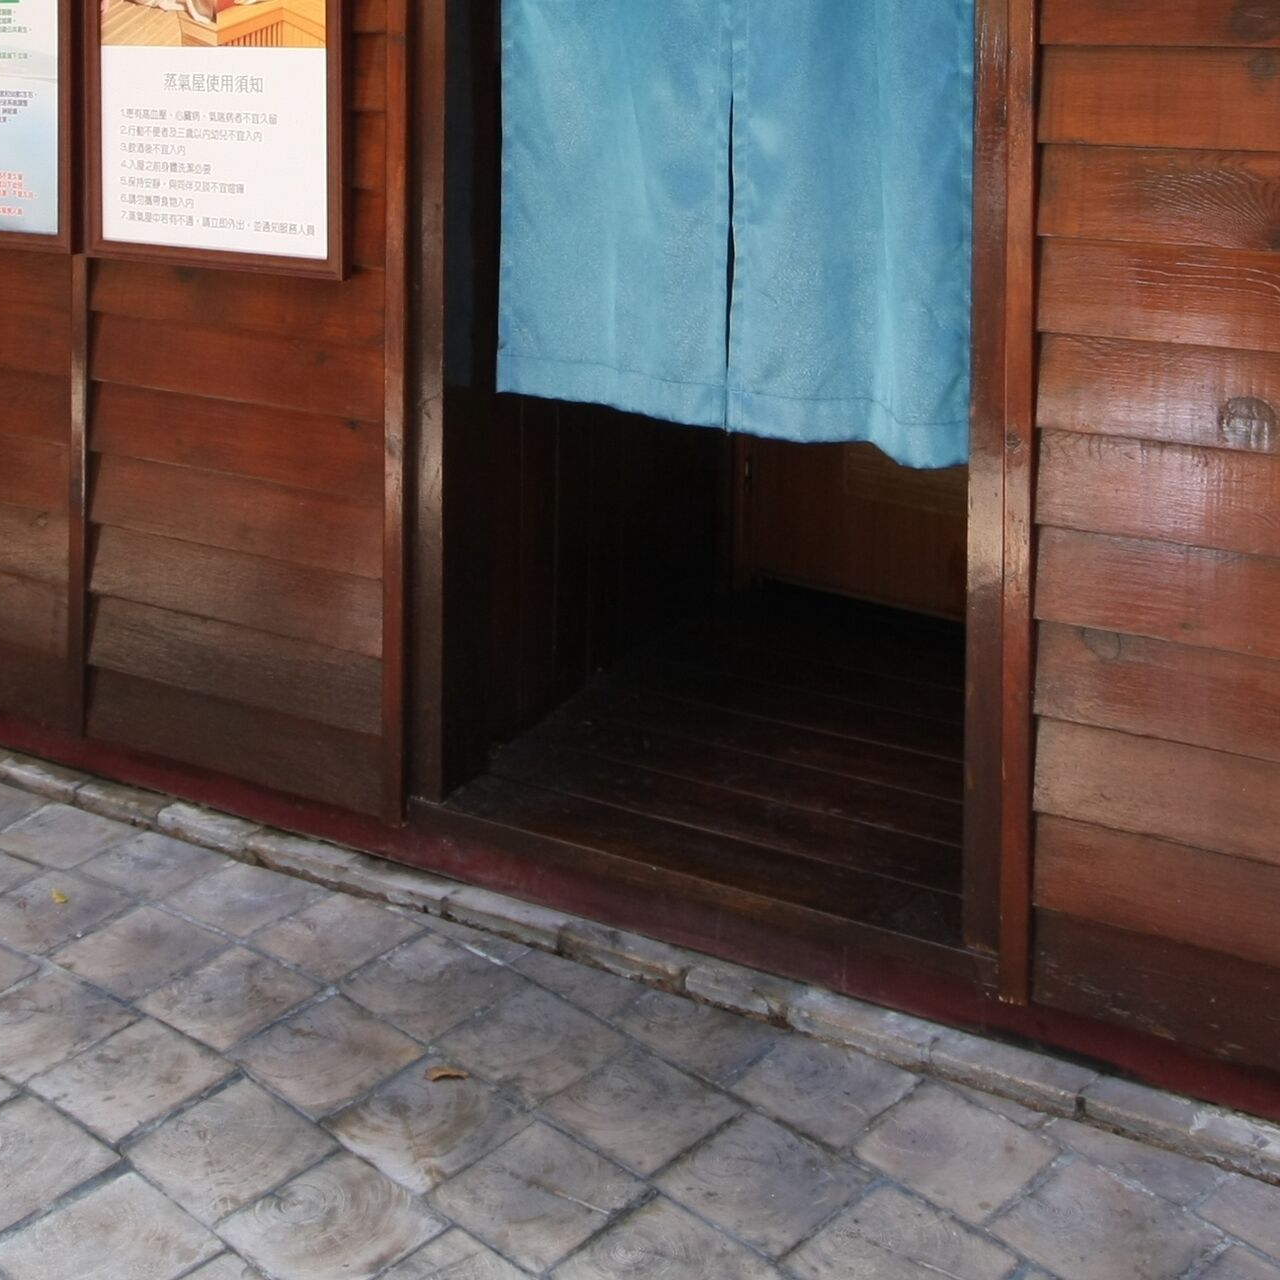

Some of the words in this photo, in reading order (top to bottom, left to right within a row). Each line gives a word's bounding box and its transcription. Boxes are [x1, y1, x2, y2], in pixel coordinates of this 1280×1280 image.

[164, 73, 264, 94] 蒸氣屋使用須知
